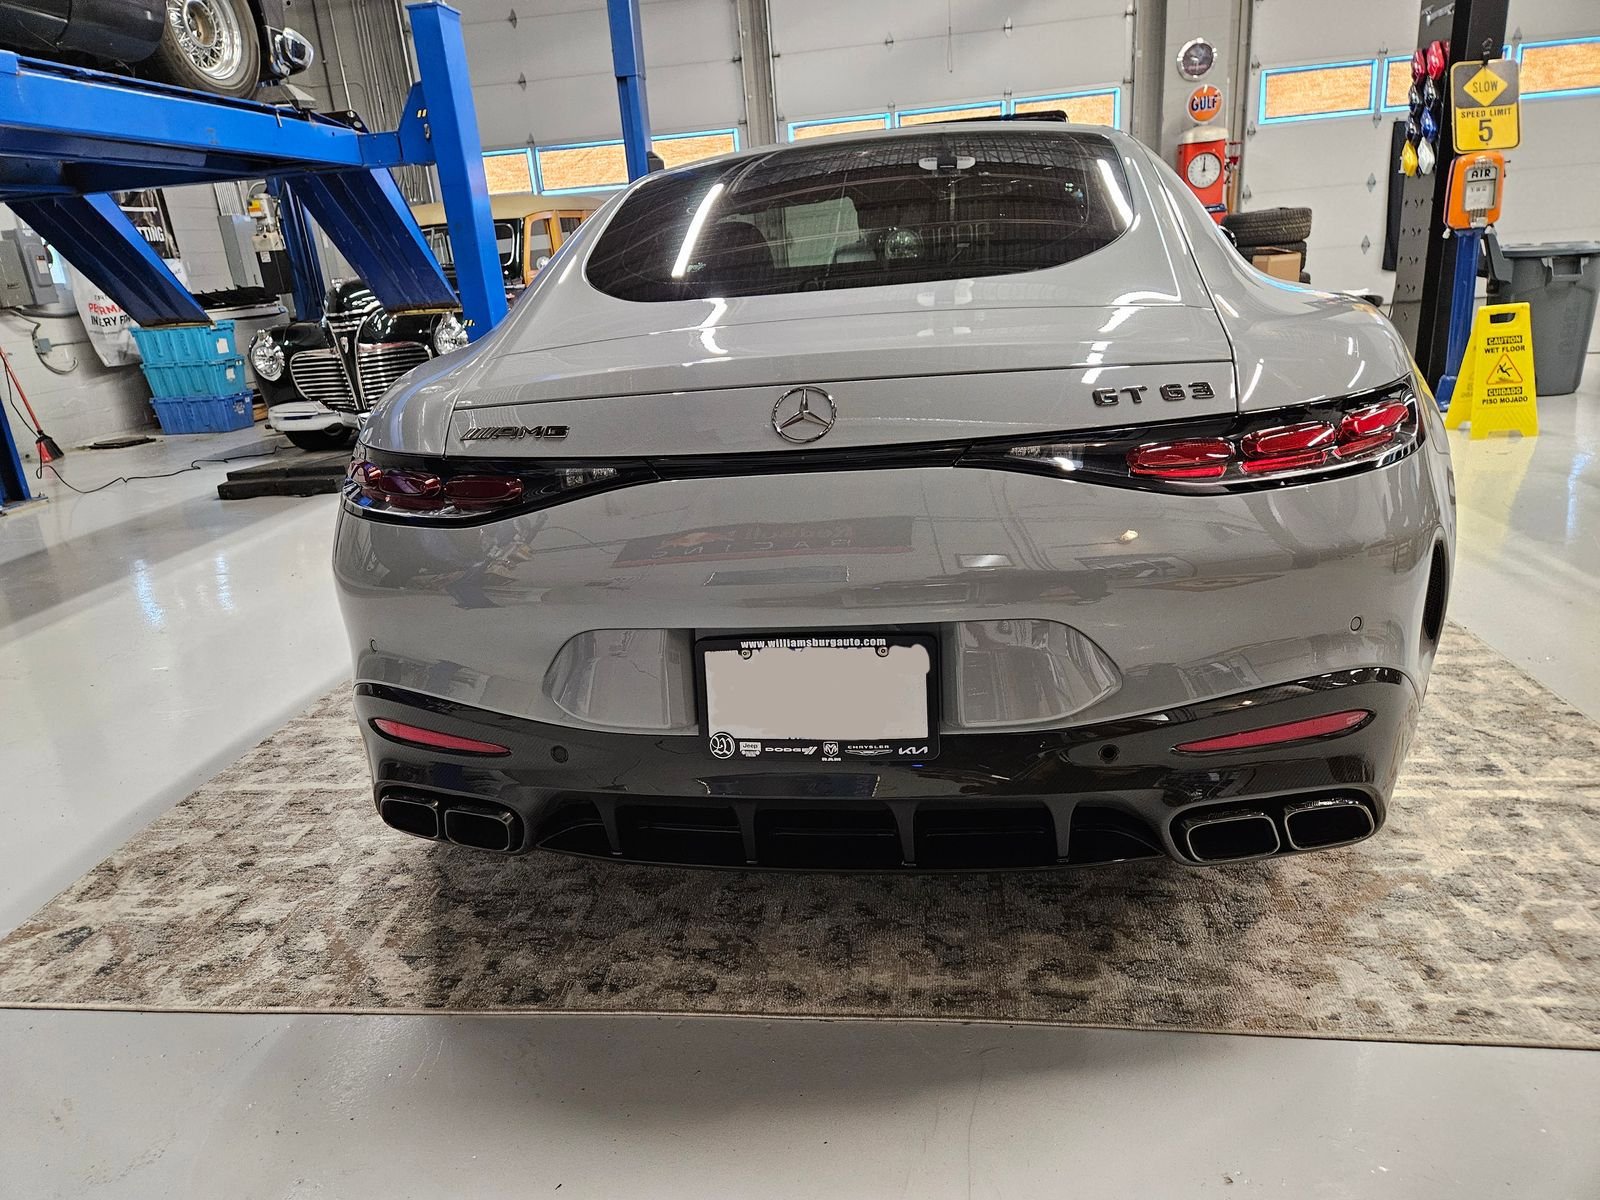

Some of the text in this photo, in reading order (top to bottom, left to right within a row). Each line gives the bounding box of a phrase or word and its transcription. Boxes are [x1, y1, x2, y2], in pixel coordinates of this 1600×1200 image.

[1472, 80, 1498, 93] SLOW
[1190, 95, 1217, 112] GULF
[1460, 107, 1512, 119] SPEED LIMIT
[1478, 119, 1494, 142] 5
[1471, 168, 1491, 179] AIR
[1487, 335, 1522, 345] CAUTION
[1501, 345, 1525, 353] FLOOR
[1092, 382, 1216, 406] GT 63
[1487, 387, 1522, 396] CUIDADO
[1500, 396, 1528, 404] MOJADO
[740, 638, 887, 649] www.williamsburgauto.com
